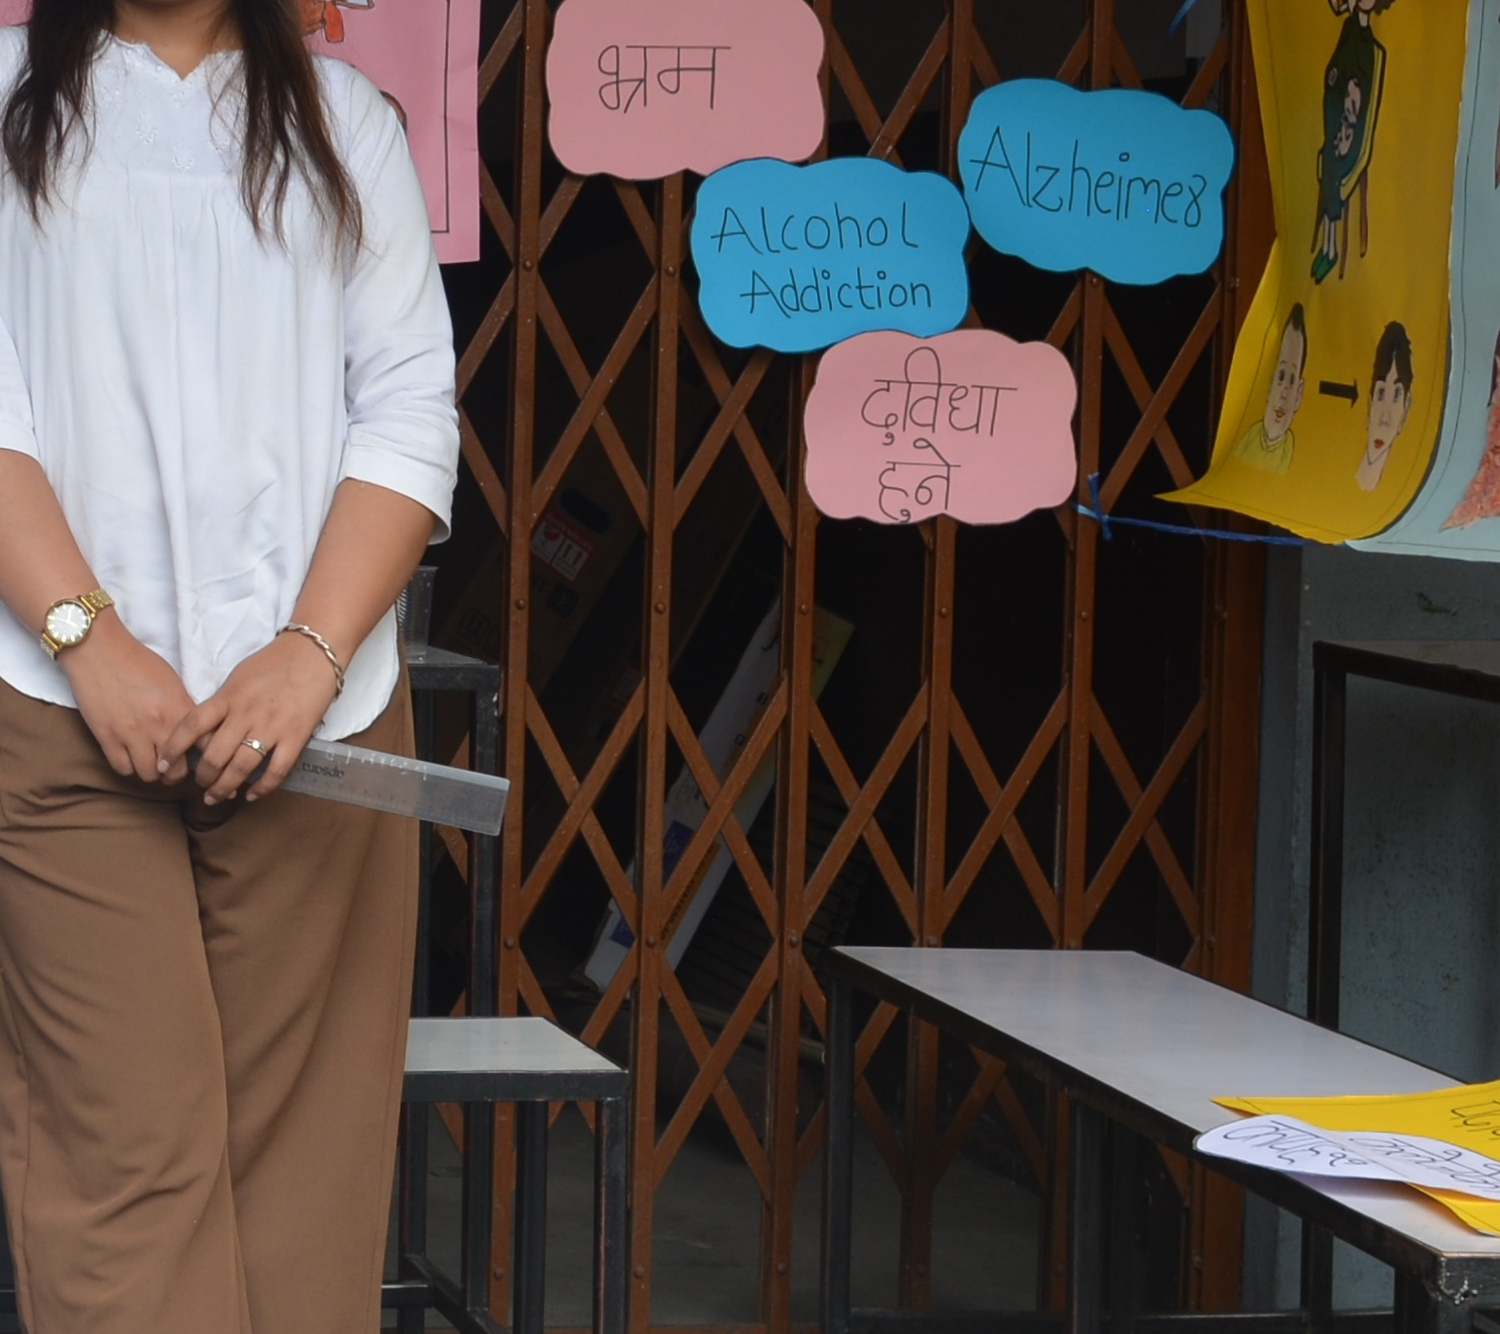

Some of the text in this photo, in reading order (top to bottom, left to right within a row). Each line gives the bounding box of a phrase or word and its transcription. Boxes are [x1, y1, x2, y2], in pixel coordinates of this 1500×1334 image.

[596, 43, 733, 115] भ्रम
[709, 201, 920, 255] Alcohol
[738, 266, 933, 319] Addiction
